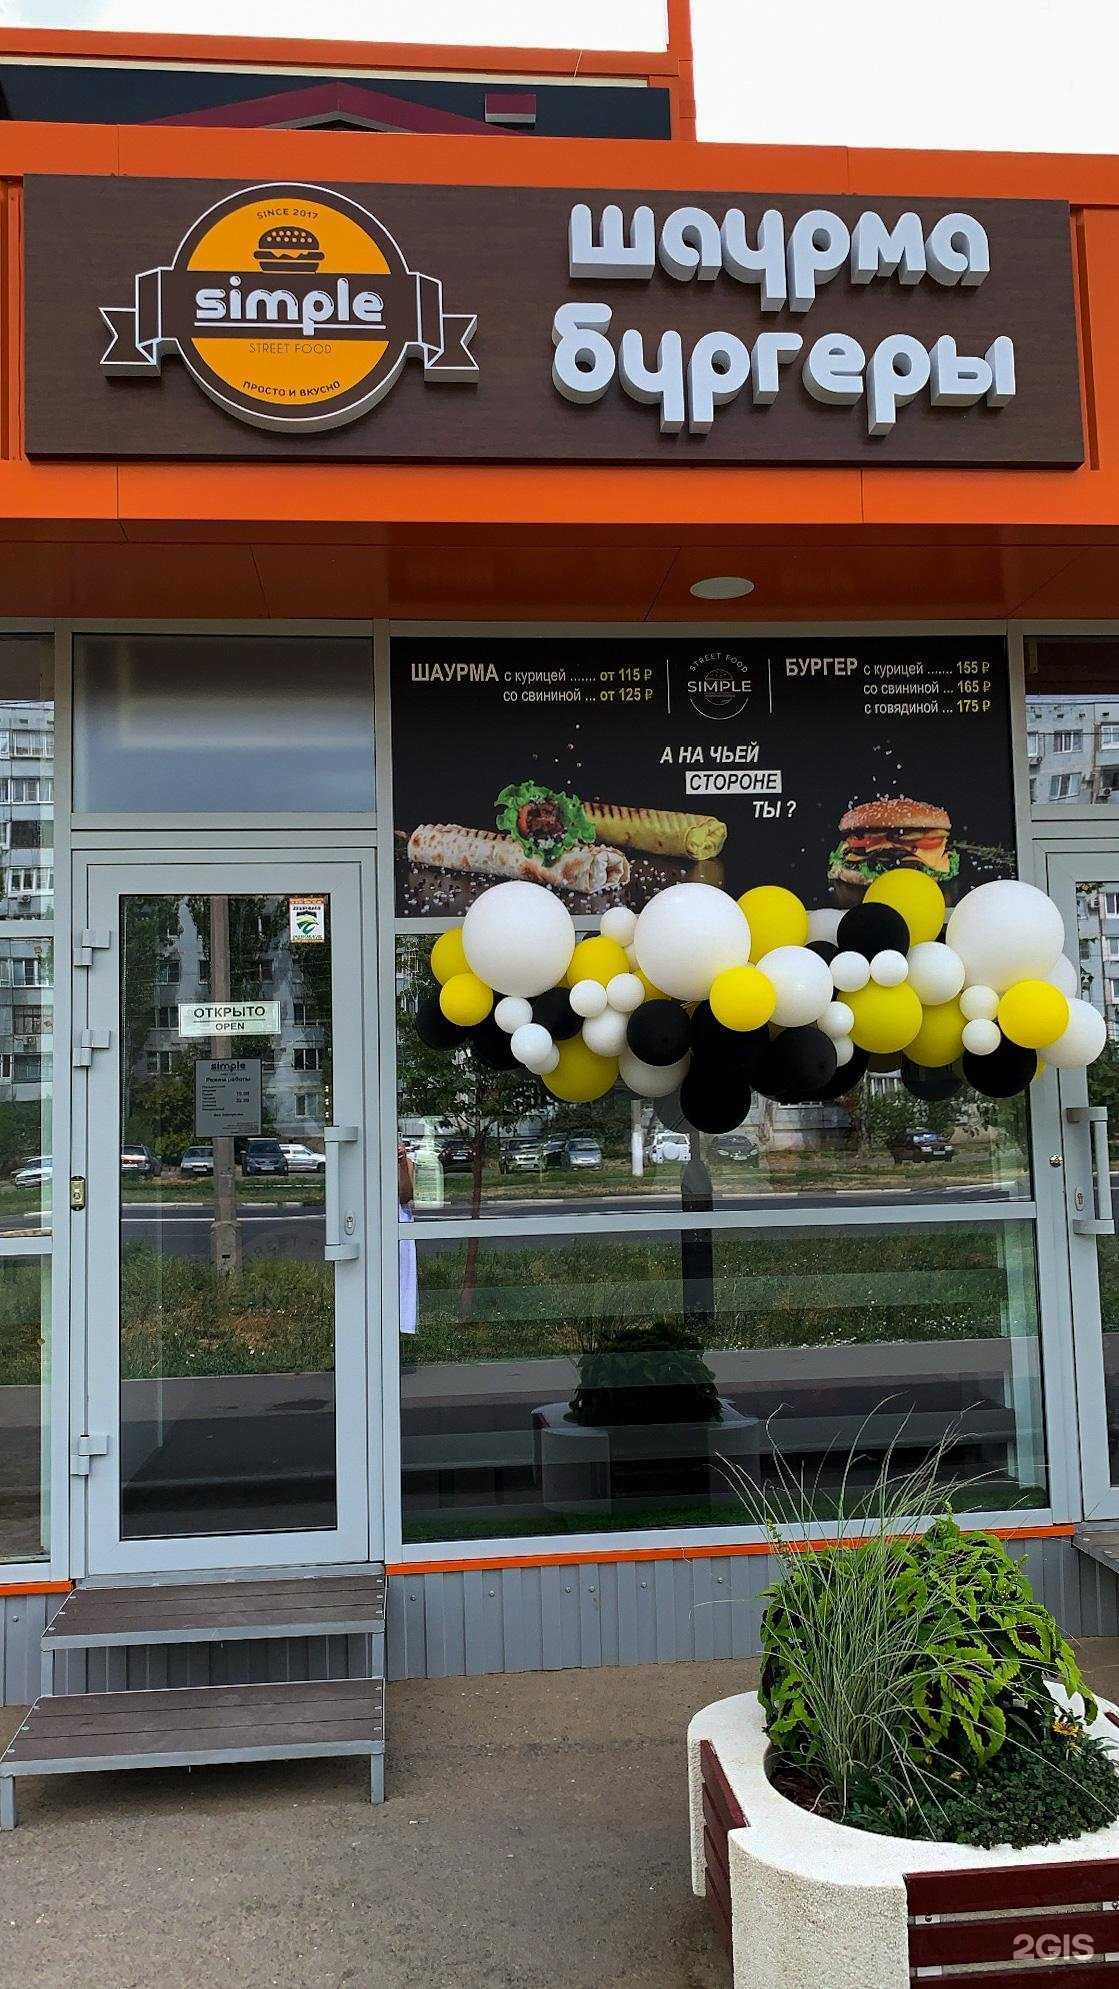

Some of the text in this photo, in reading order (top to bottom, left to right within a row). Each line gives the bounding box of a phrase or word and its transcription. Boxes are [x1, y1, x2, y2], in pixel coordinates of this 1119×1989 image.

[257, 208, 319, 220] SINCE 2017
[569, 203, 991, 312] шаурма
[195, 275, 384, 336] simple
[249, 343, 332, 354] STREET FOOD
[552, 302, 1017, 435] бургеры
[242, 380, 341, 397] ПРОСТО И ВКУСНО
[689, 652, 748, 673] STREET FOOD
[785, 657, 858, 677] БУРГЕР
[863, 664, 871, 676] с
[875, 661, 924, 679] курицей
[957, 660, 979, 674] 155
[411, 663, 500, 683] ШАУРМА
[504, 671, 512, 682] с
[515, 668, 566, 685] курицей
[600, 671, 615, 682] от
[618, 667, 641, 682] 115
[503, 690, 518, 702] со
[521, 687, 582, 702] свининой
[600, 690, 615, 702] от
[618, 687, 642, 702] 125
[687, 680, 753, 693] SIMPLE
[863, 684, 878, 695] со
[881, 681, 940, 695] свининой
[957, 680, 979, 693] 165
[864, 703, 872, 715] с
[874, 700, 939, 716] говядиной
[957, 700, 979, 713] 175
[660, 741, 760, 764] А НА ЧЬЕЙ
[689, 773, 778, 791] СТОРОНЕ
[193, 1006, 266, 1019] ОТКРЫТО
[215, 1022, 245, 1031] OPEN
[210, 1061, 246, 1072] simple
